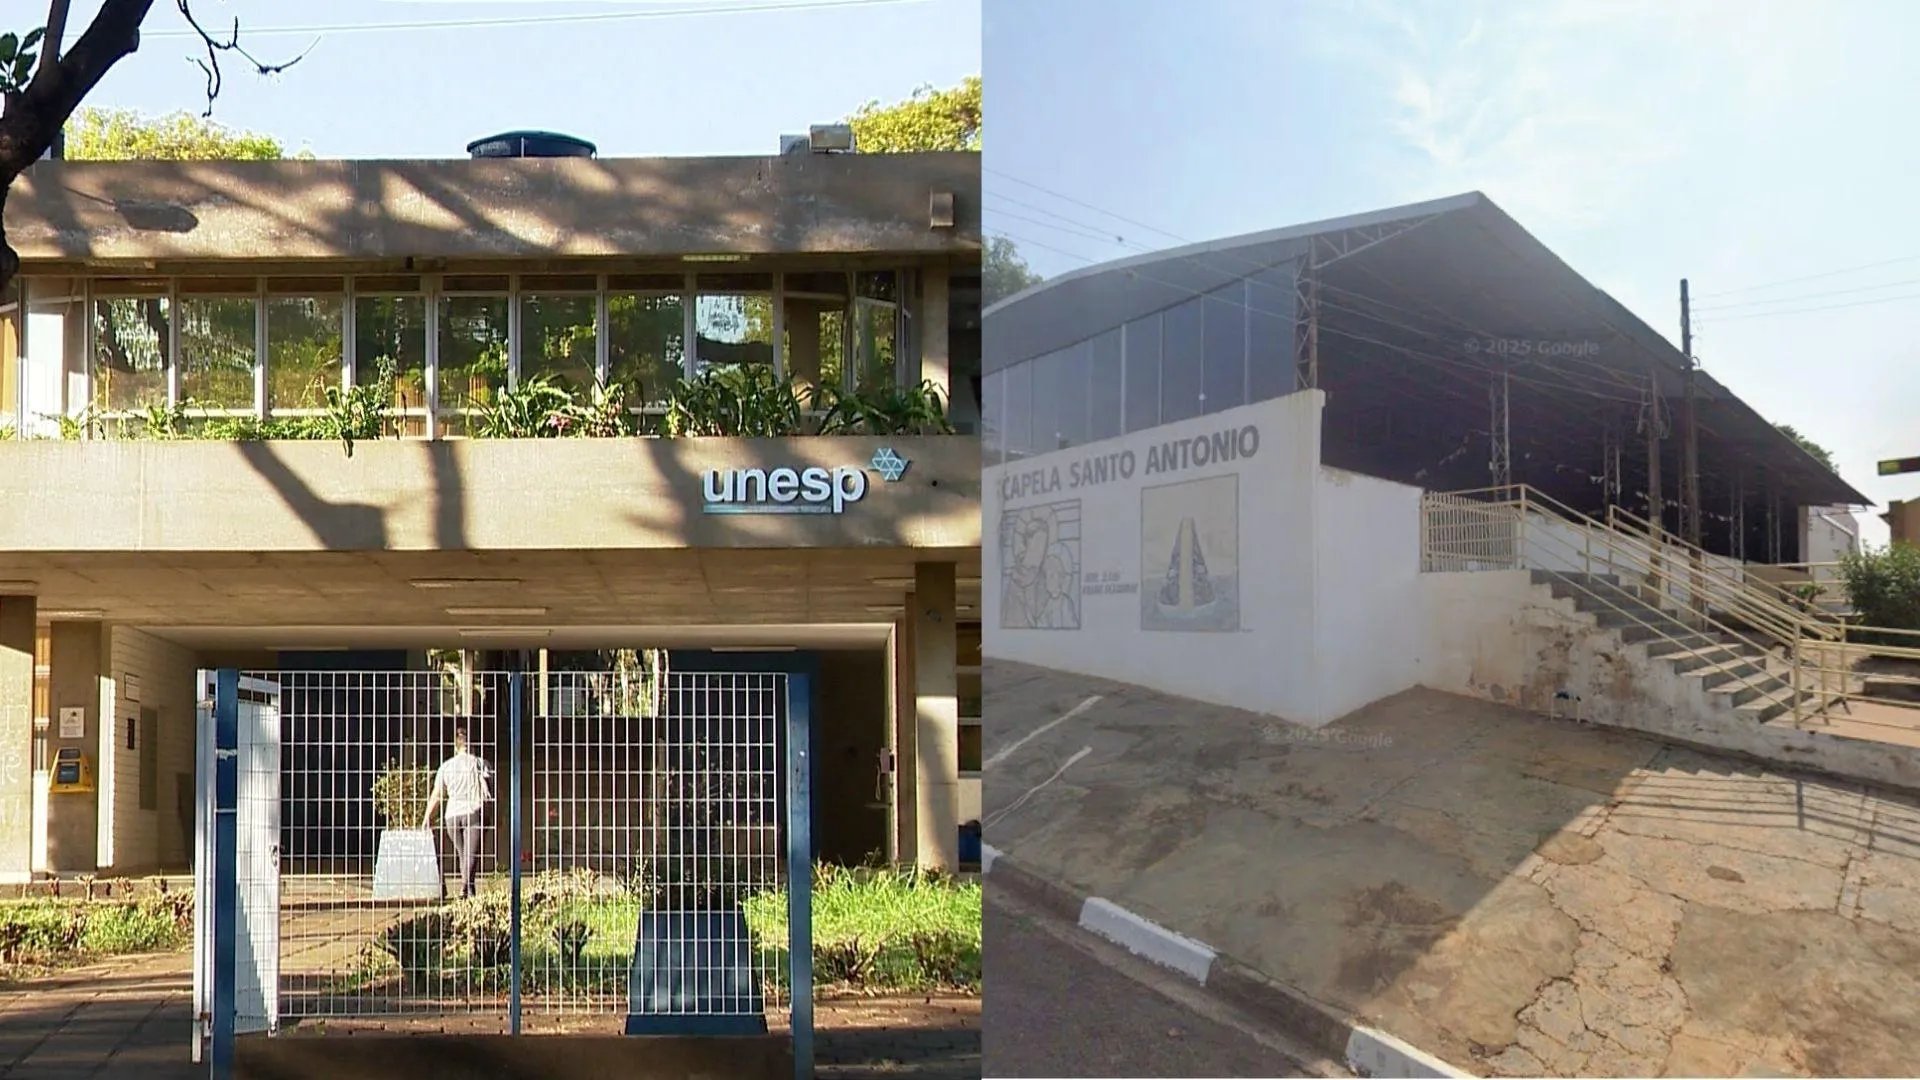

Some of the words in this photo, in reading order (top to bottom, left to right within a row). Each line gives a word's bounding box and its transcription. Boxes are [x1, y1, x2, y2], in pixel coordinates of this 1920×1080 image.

[703, 466, 867, 514] unesp
[1001, 466, 1062, 501] CAPELA
[1069, 450, 1136, 489] SANTO
[1145, 425, 1260, 475] ANTONIO
